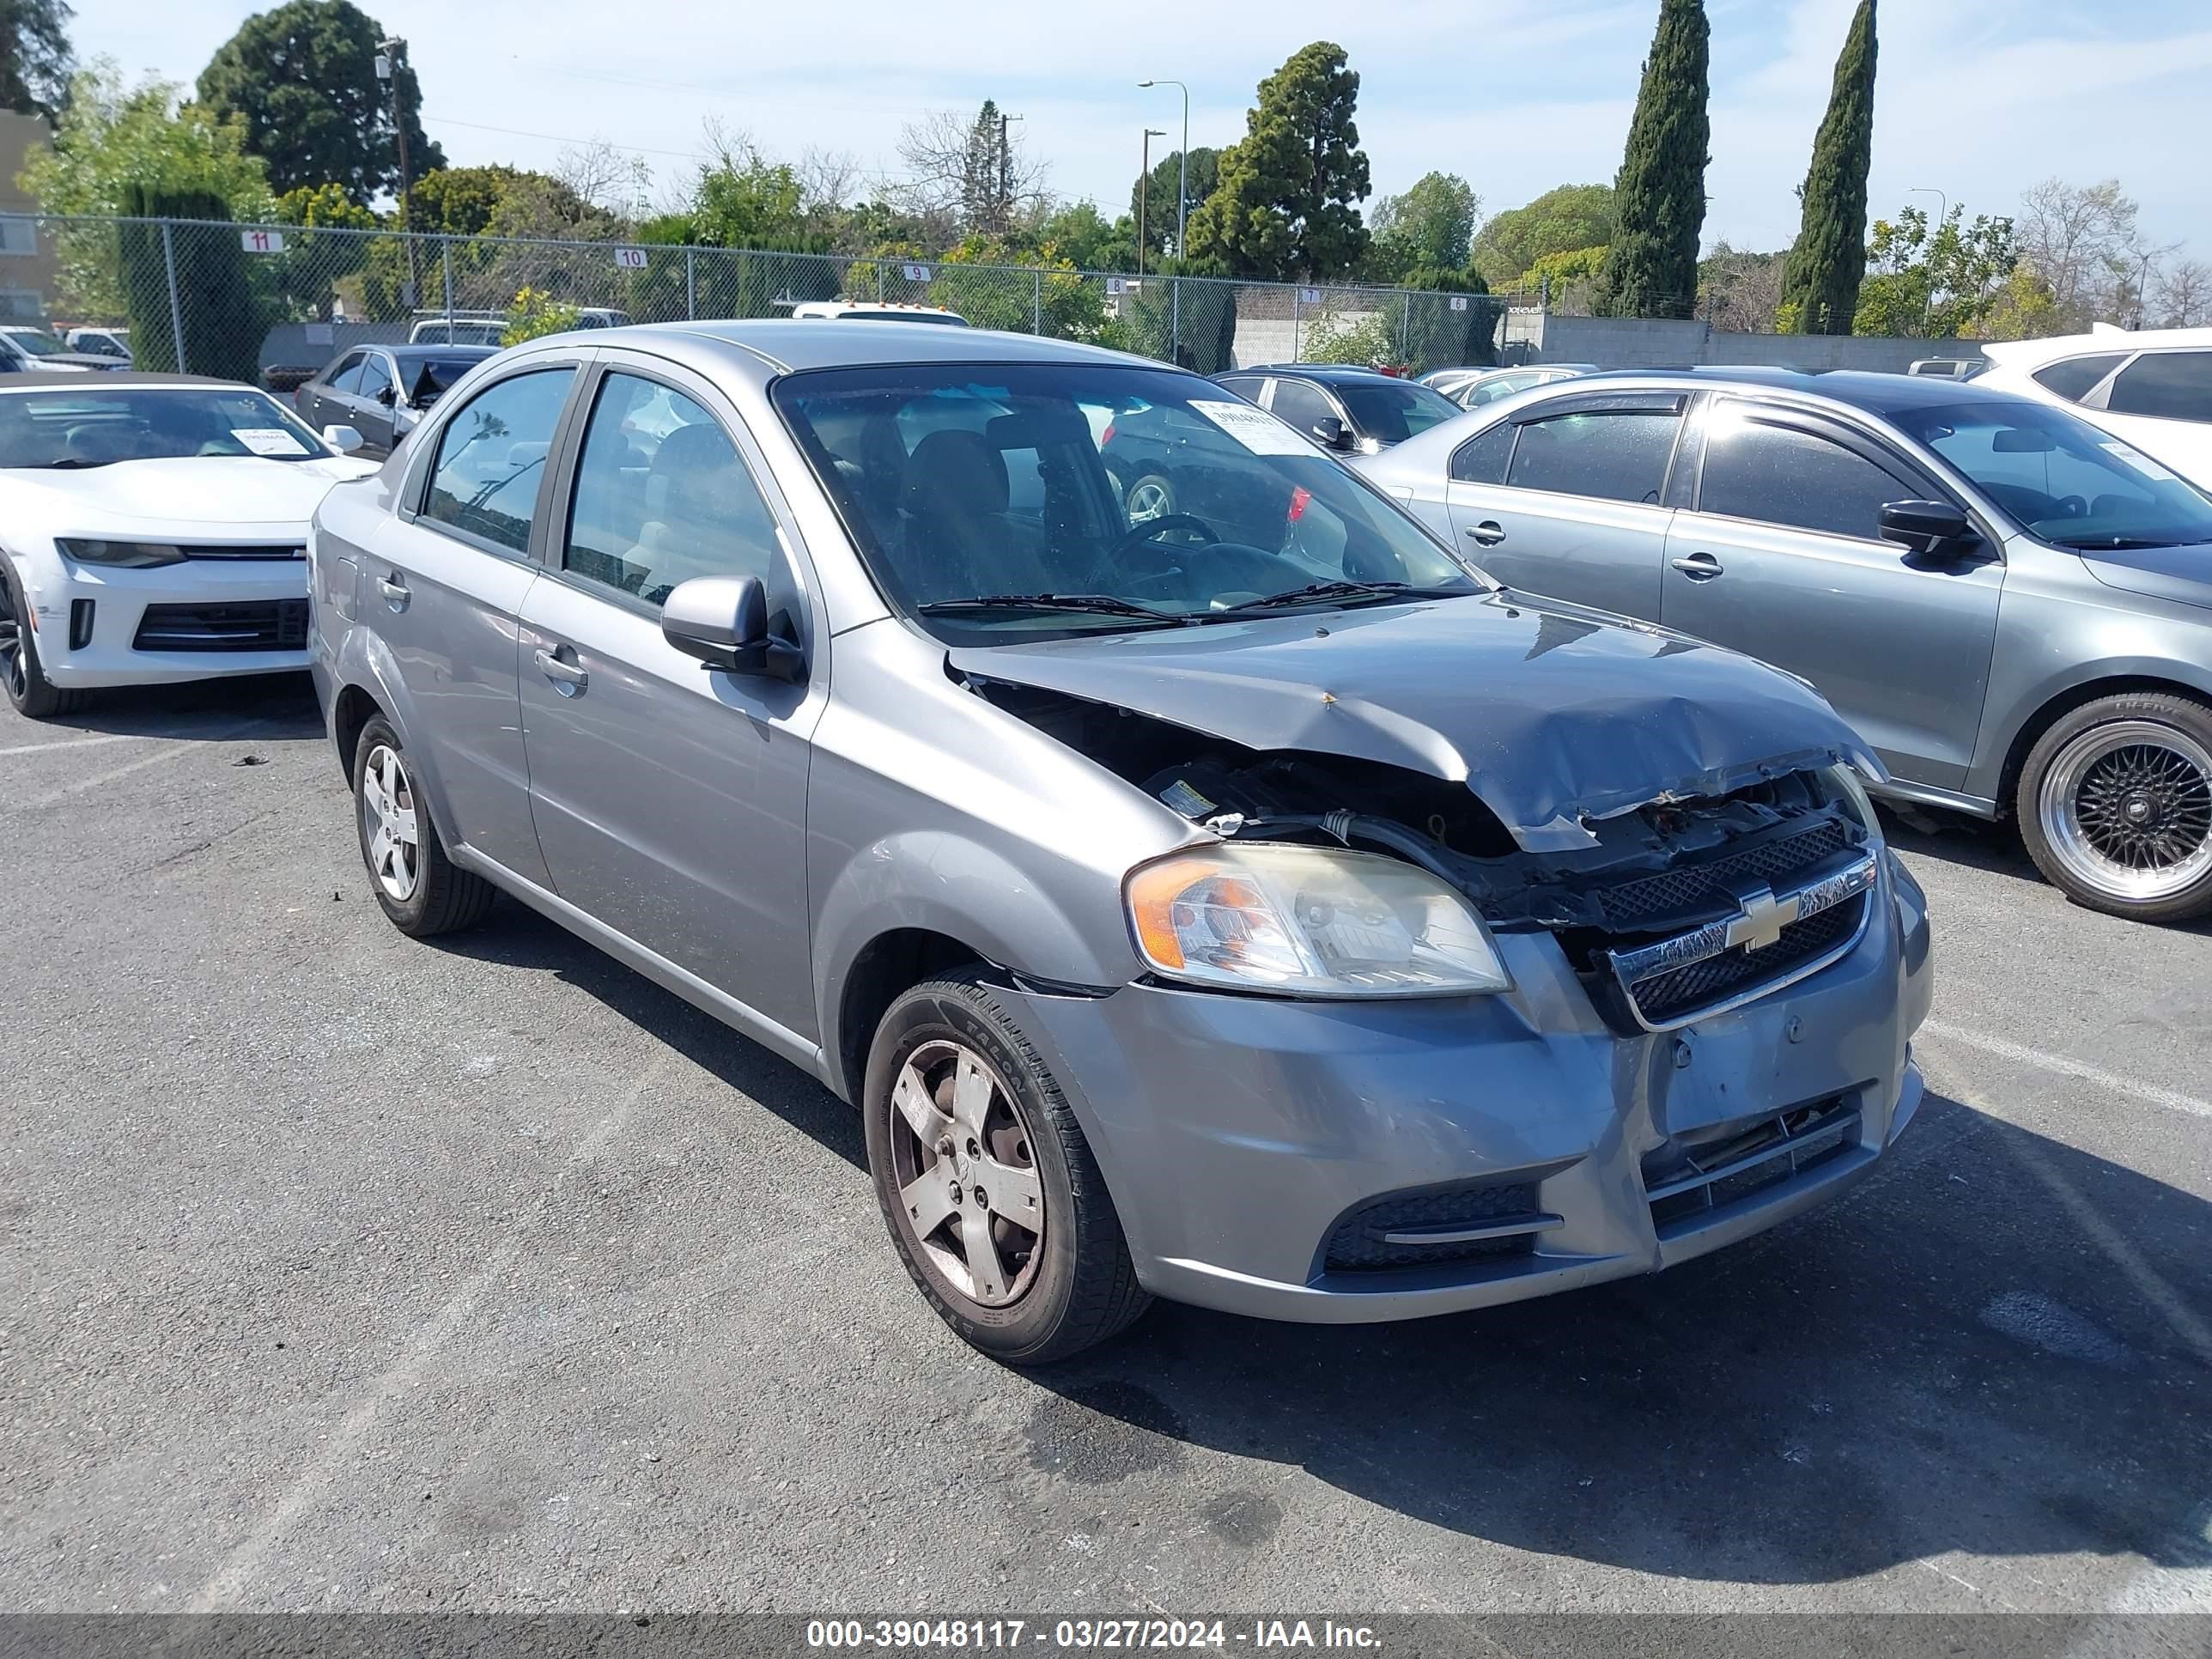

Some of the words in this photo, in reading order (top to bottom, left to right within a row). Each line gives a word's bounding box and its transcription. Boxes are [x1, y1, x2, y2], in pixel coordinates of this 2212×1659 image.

[252, 233, 269, 250] 11
[623, 251, 641, 265] 10
[913, 267, 921, 279] 9
[1114, 280, 1121, 292] 8
[1308, 290, 1314, 301] 7
[1455, 299, 1462, 309] 6
[2115, 701, 2185, 715] LH-FIVE
[966, 1019, 1027, 1094] TALON
